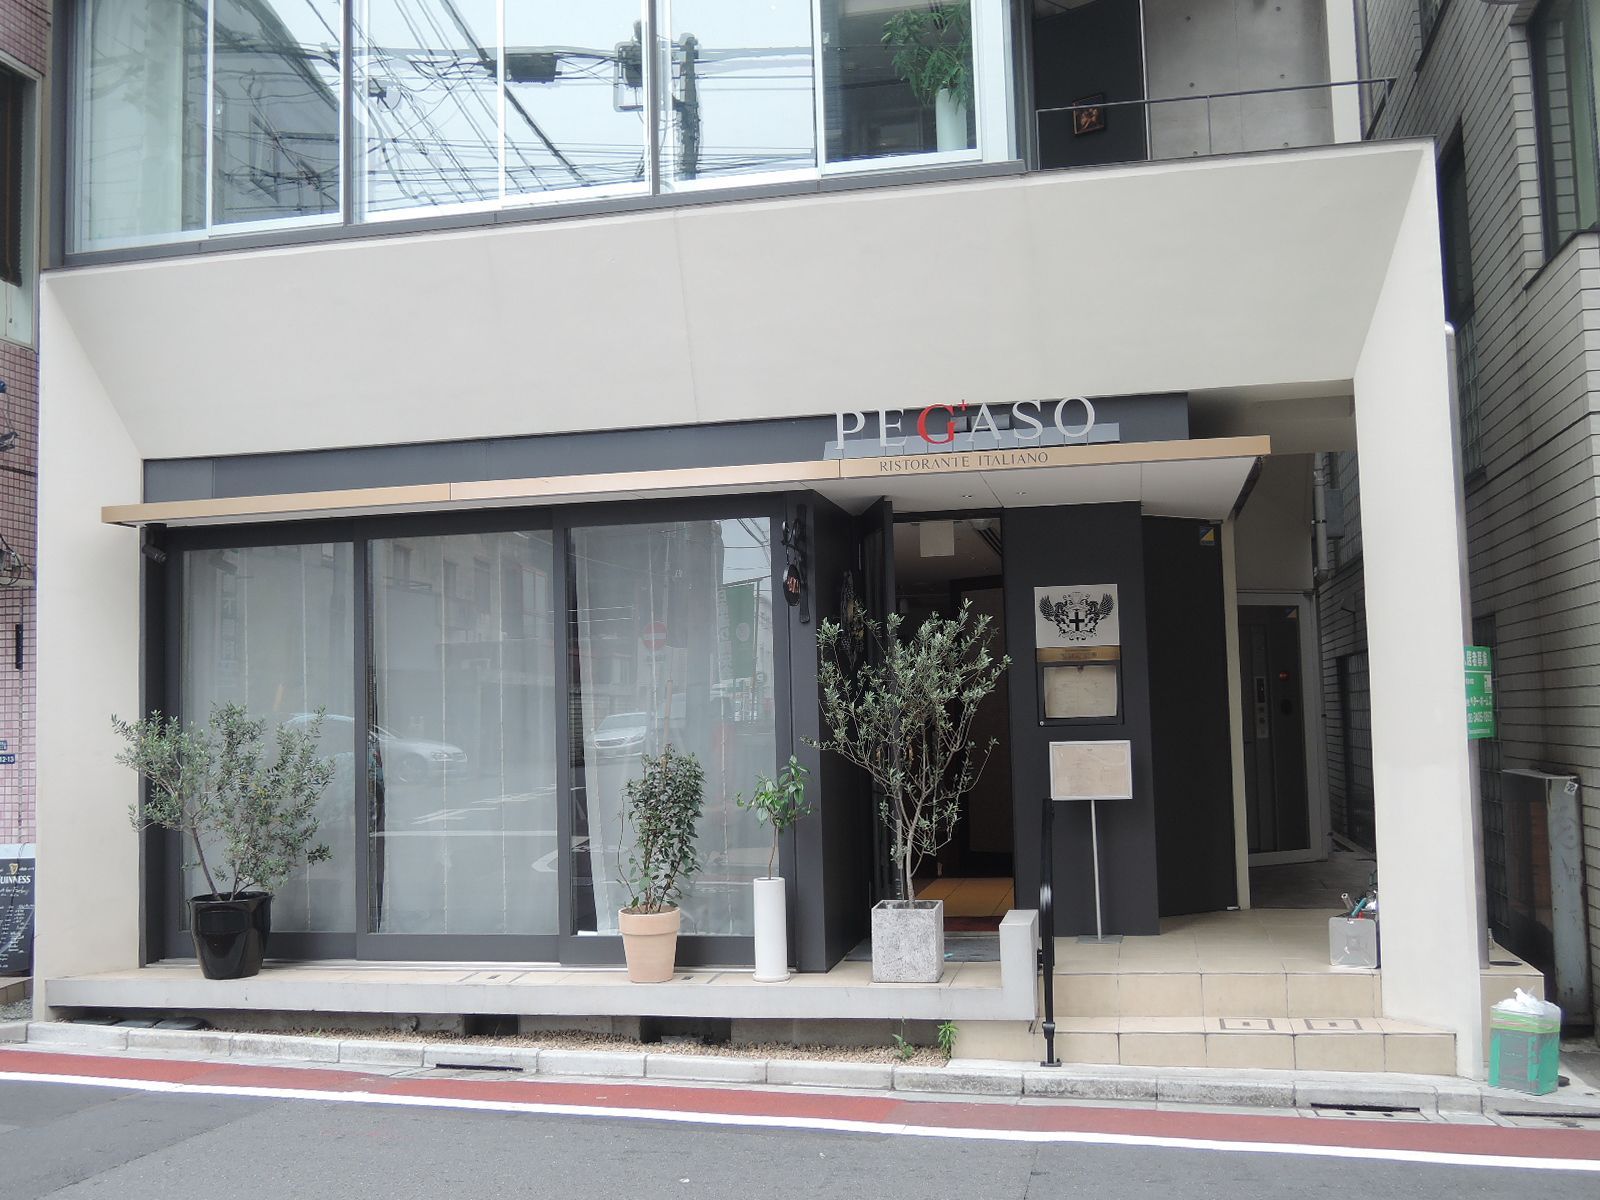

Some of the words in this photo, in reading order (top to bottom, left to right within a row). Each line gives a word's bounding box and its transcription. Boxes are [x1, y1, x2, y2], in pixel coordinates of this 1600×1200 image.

[835, 397, 1096, 450] PEGASO
[879, 456, 970, 472] RISTORANTE
[978, 451, 1049, 466] ITALIANO
[0, 875, 32, 884] UINNESS
